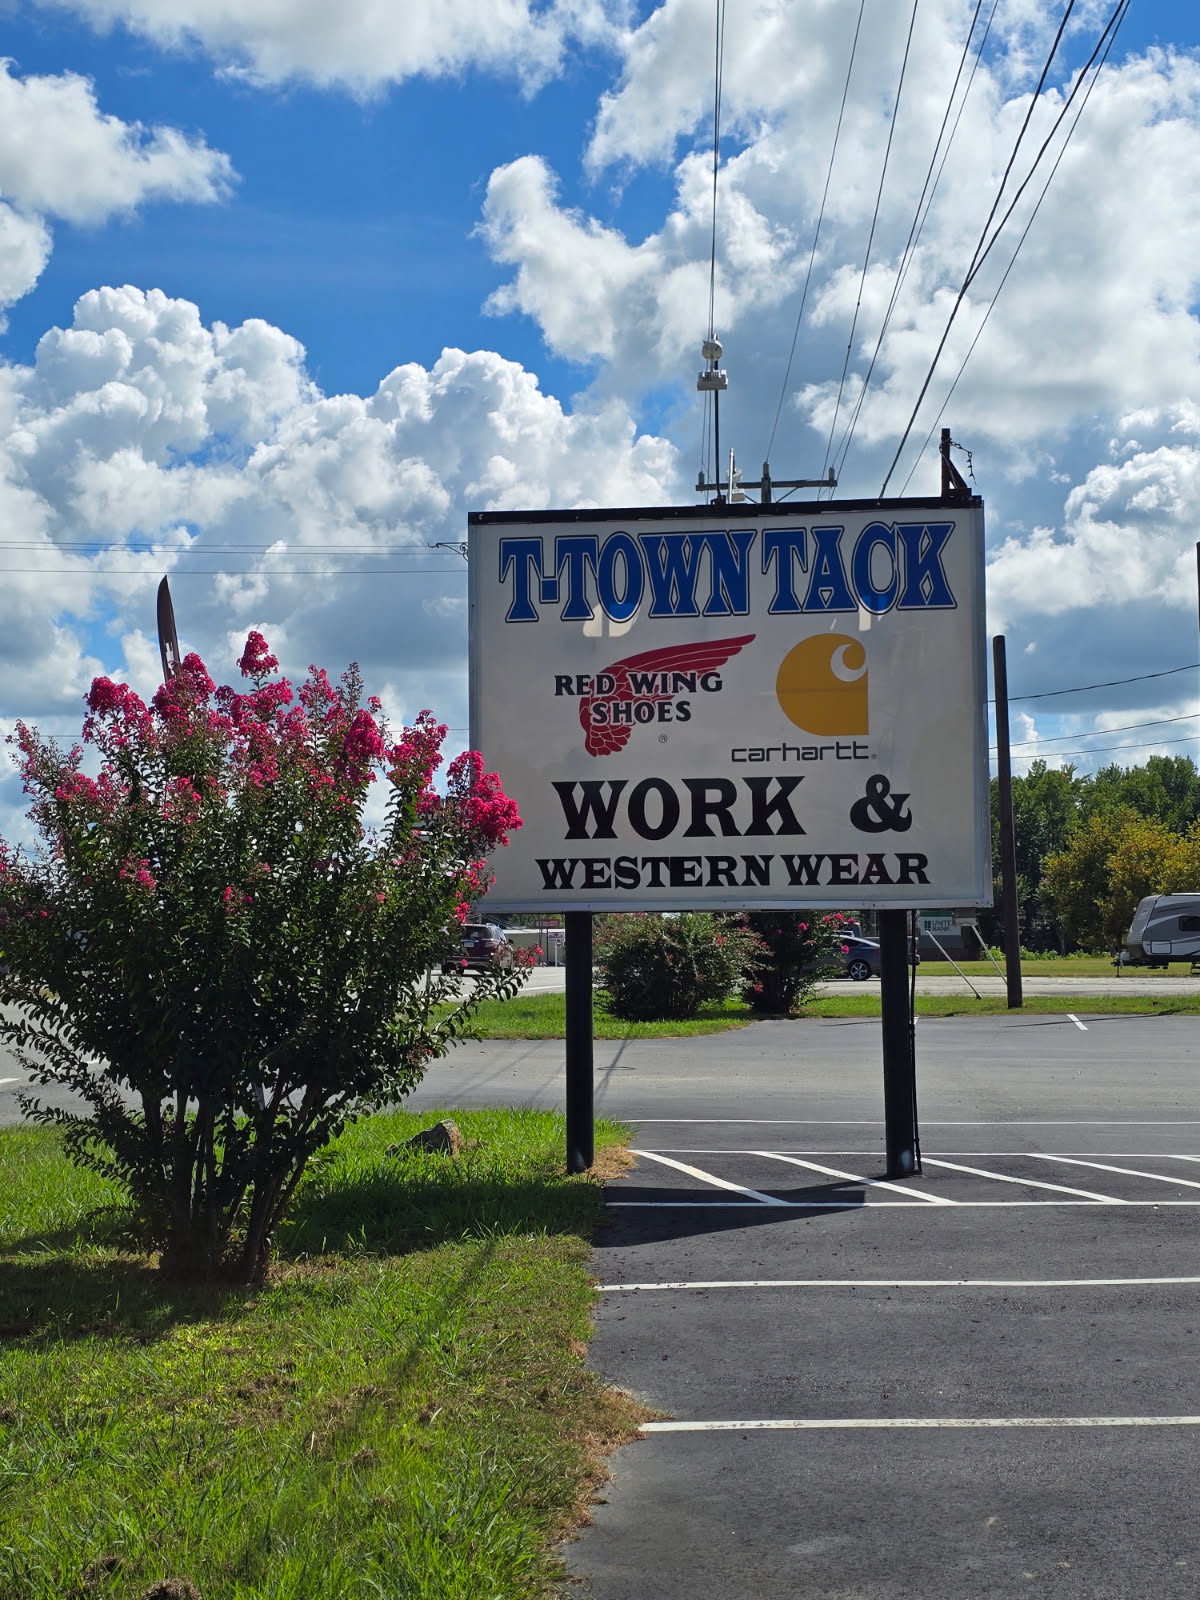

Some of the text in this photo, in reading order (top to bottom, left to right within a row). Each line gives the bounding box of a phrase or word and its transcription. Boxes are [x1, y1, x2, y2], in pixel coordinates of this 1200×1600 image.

[499, 521, 957, 623] T-TOWN TACK
[555, 672, 723, 696] RED WING
[592, 701, 692, 724] SHOES
[732, 741, 869, 762] carhartt
[551, 774, 912, 840] WORK &
[535, 853, 931, 890] WESTERN WEAR
